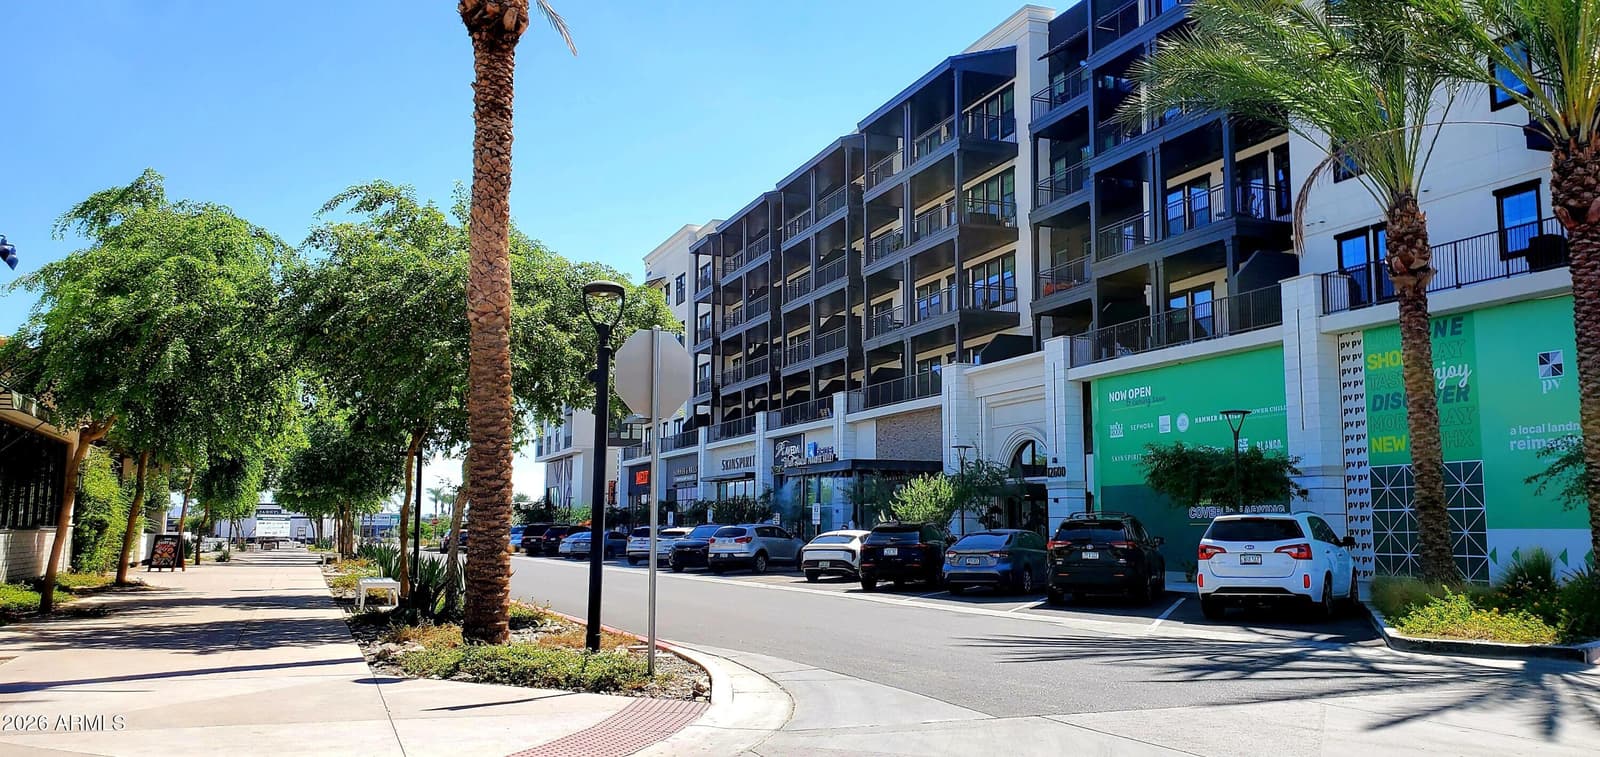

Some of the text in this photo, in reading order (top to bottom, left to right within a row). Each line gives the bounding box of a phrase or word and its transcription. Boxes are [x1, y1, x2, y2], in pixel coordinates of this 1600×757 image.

[1369, 361, 1472, 390] TAS njoy
[1109, 386, 1152, 403] NOW OPEN
[1543, 379, 1561, 394] pv
[1370, 414, 1407, 433] MOR
[1510, 428, 1516, 436] a
[1519, 424, 1545, 434] local
[1372, 429, 1474, 454] NEW HX
